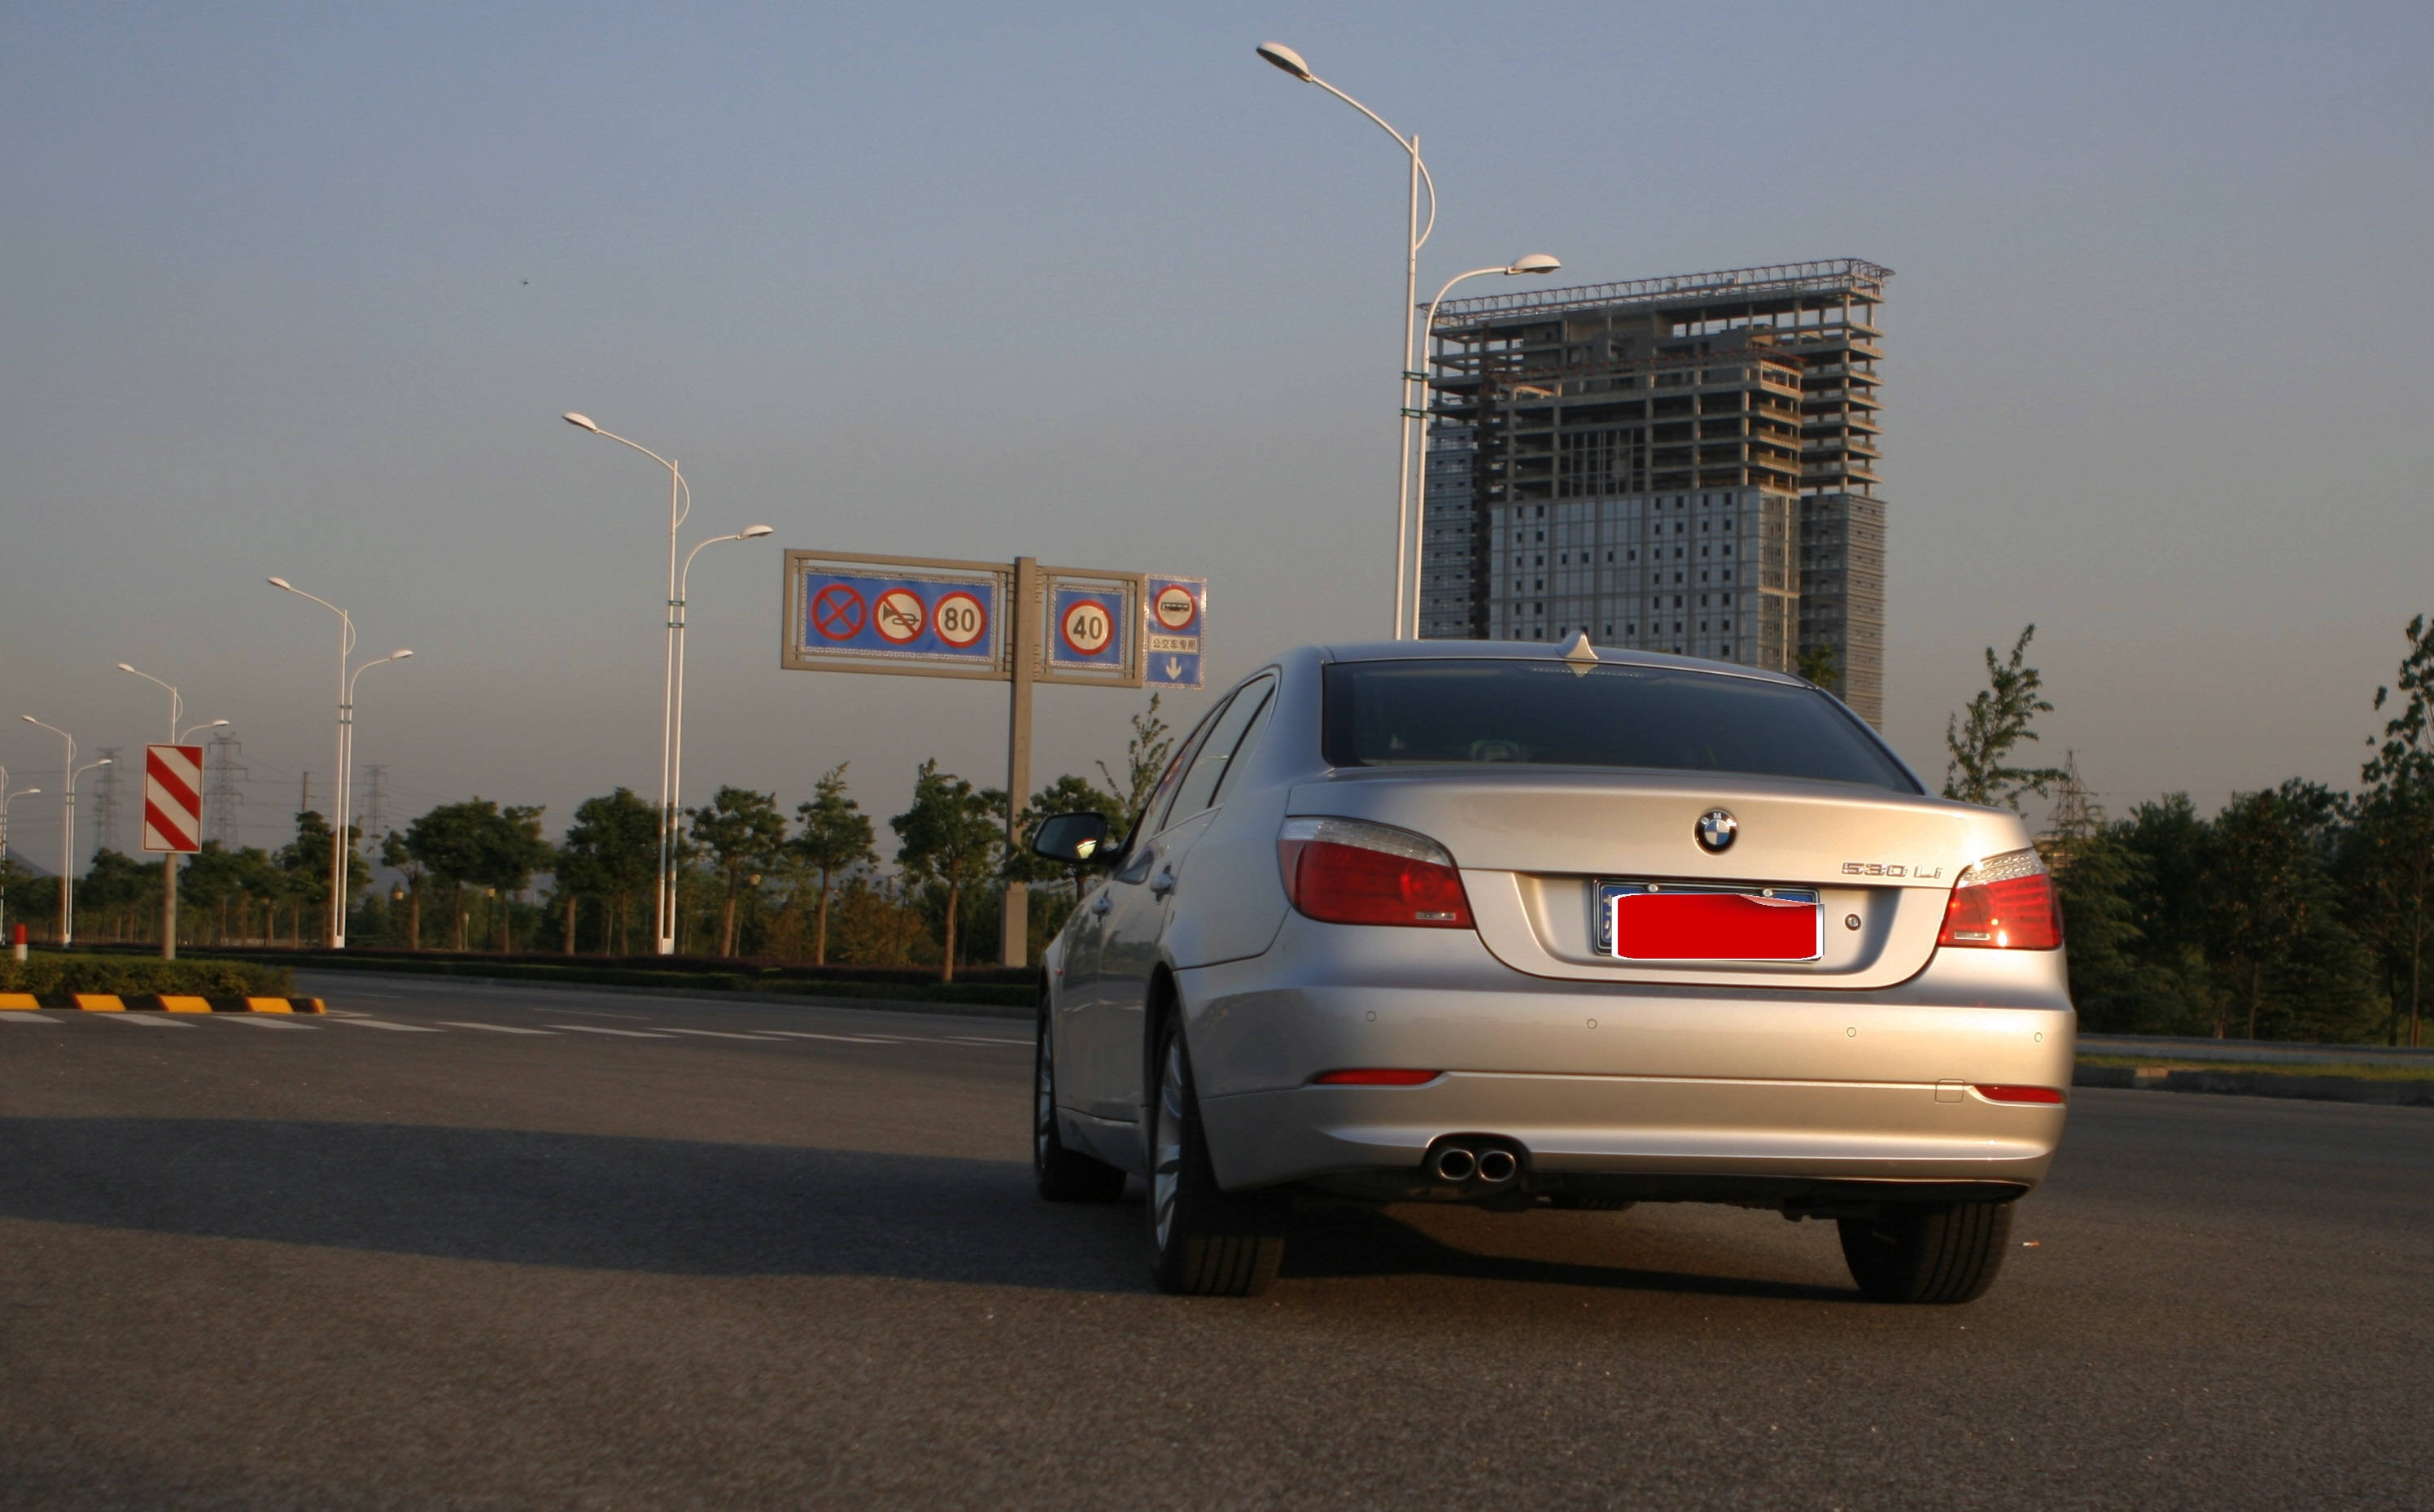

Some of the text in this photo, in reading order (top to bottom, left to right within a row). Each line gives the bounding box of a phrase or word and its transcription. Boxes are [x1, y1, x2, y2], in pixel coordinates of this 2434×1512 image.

[945, 607, 975, 632] 80
[1073, 615, 1103, 640] 40
[1152, 638, 1196, 650] 公交车专用
[1842, 863, 1942, 879] 530 Li
